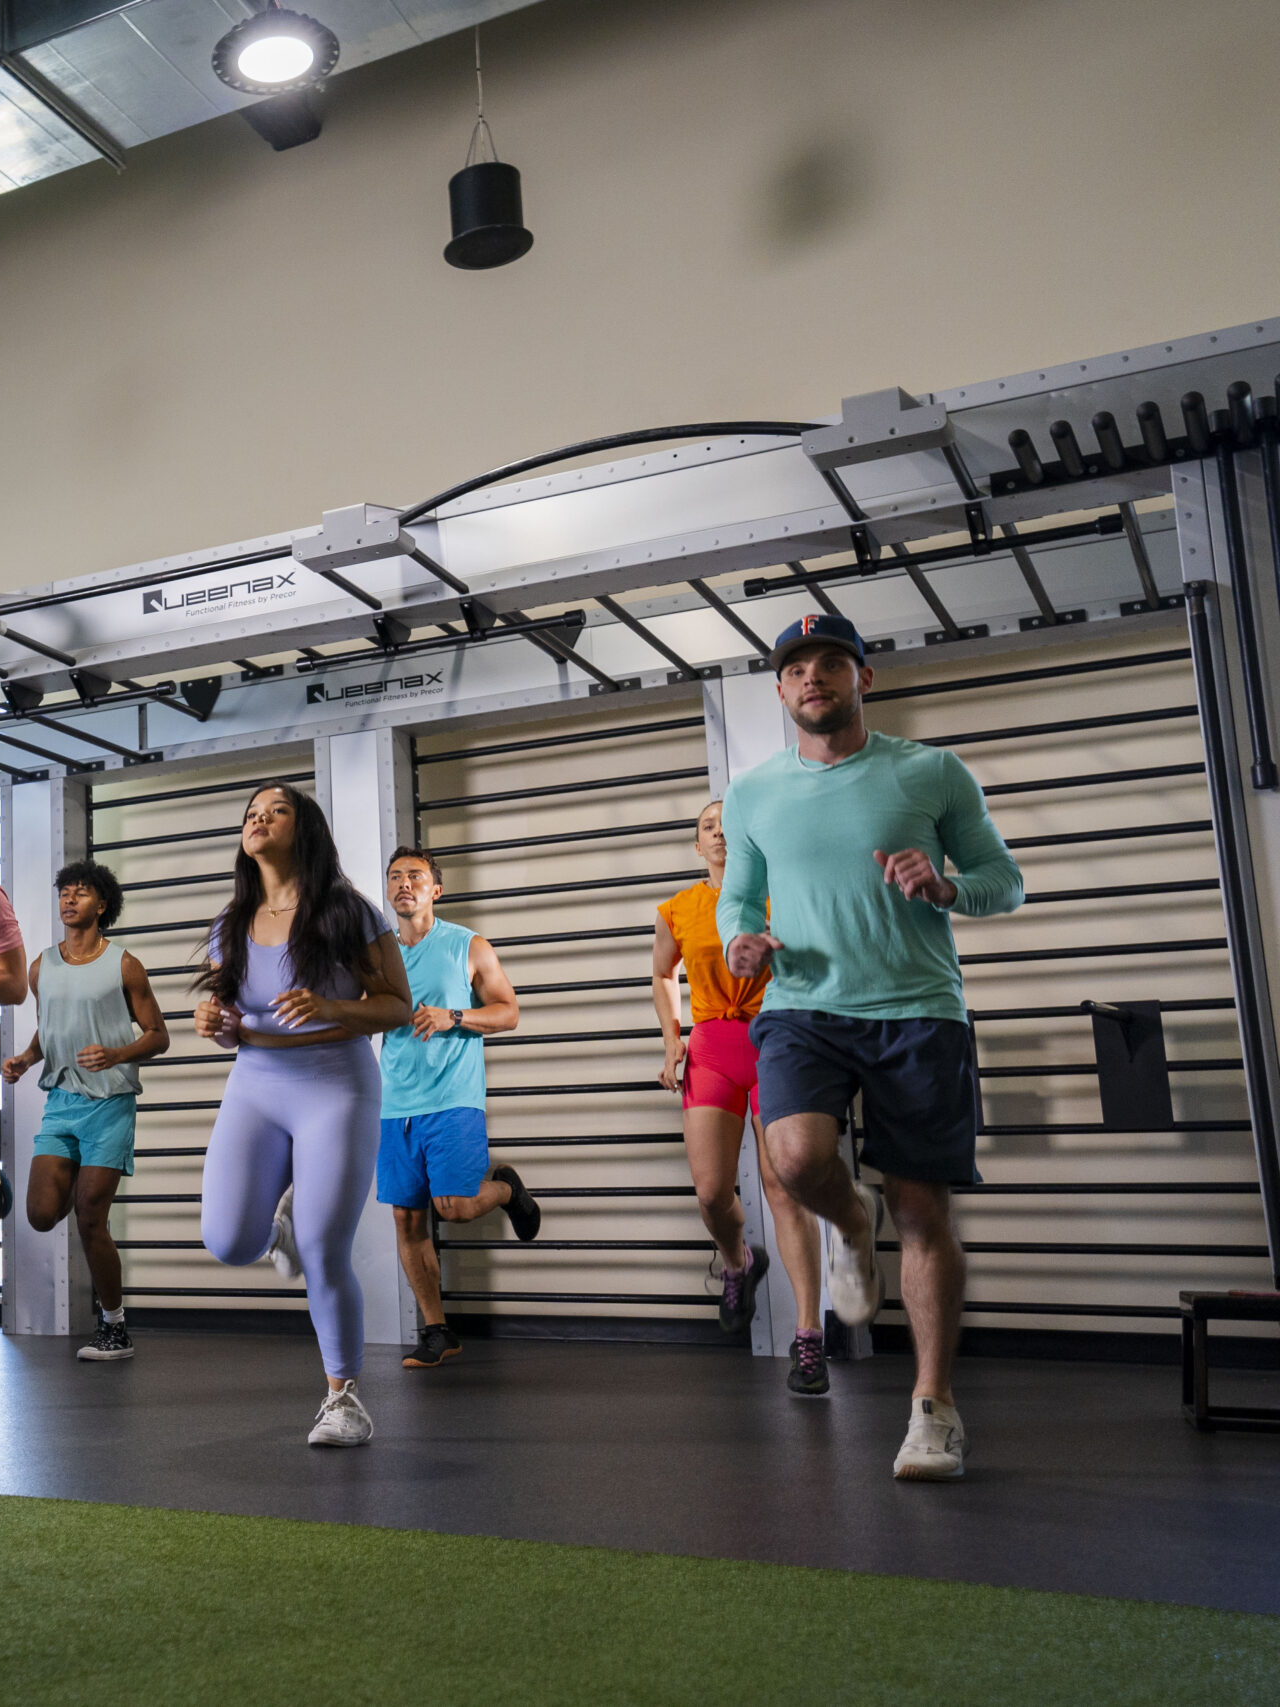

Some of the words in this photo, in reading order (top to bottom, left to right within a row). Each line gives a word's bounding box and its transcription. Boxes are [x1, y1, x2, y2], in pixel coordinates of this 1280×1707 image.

[142, 571, 297, 615] Queenax
[185, 603, 227, 617] Functional
[227, 597, 257, 609] Fitness
[257, 595, 269, 605] by
[269, 590, 298, 601] Precor
[801, 614, 819, 636] F
[306, 671, 444, 704] Queenax
[344, 695, 382, 708] Functional
[382, 692, 408, 702] Fitness
[409, 690, 419, 698] by
[420, 686, 444, 696] Precor
